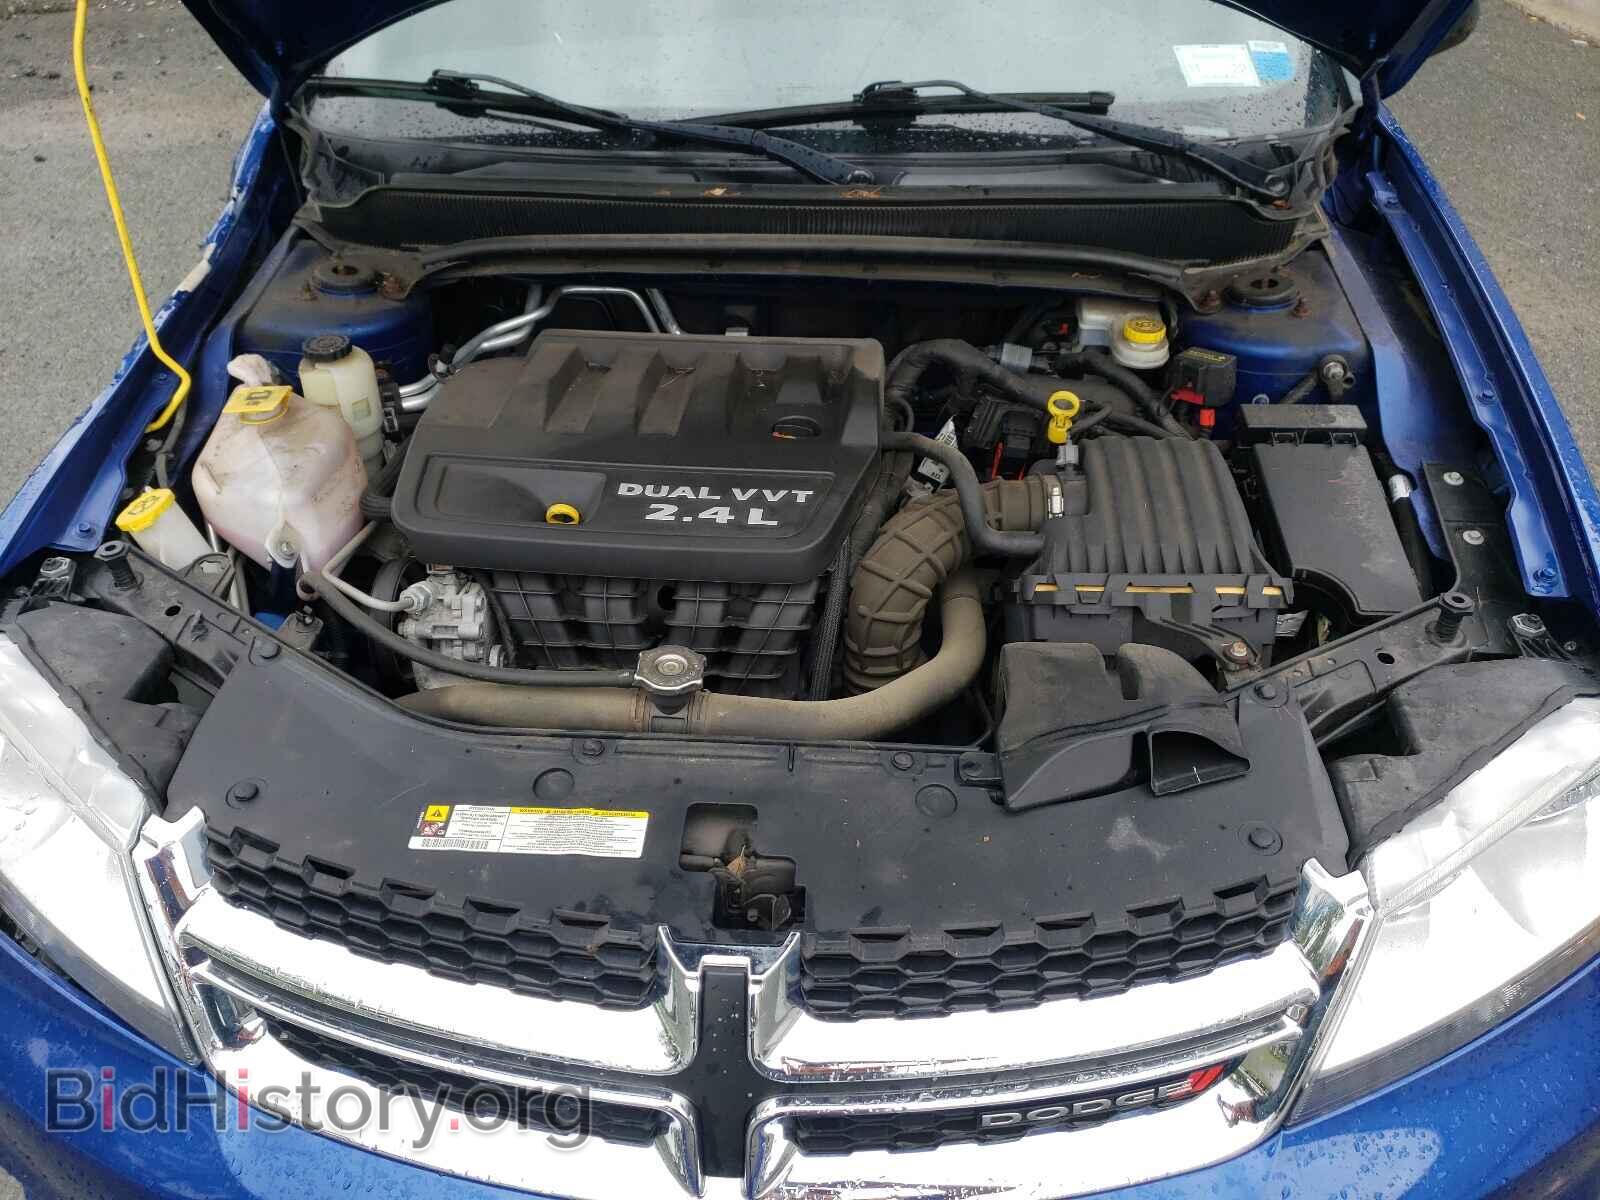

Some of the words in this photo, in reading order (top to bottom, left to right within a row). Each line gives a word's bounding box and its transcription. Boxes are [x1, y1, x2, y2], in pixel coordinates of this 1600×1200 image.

[617, 482, 721, 500] DUAL
[731, 487, 814, 503] VVT
[980, 1080, 1193, 1128] DODGE
